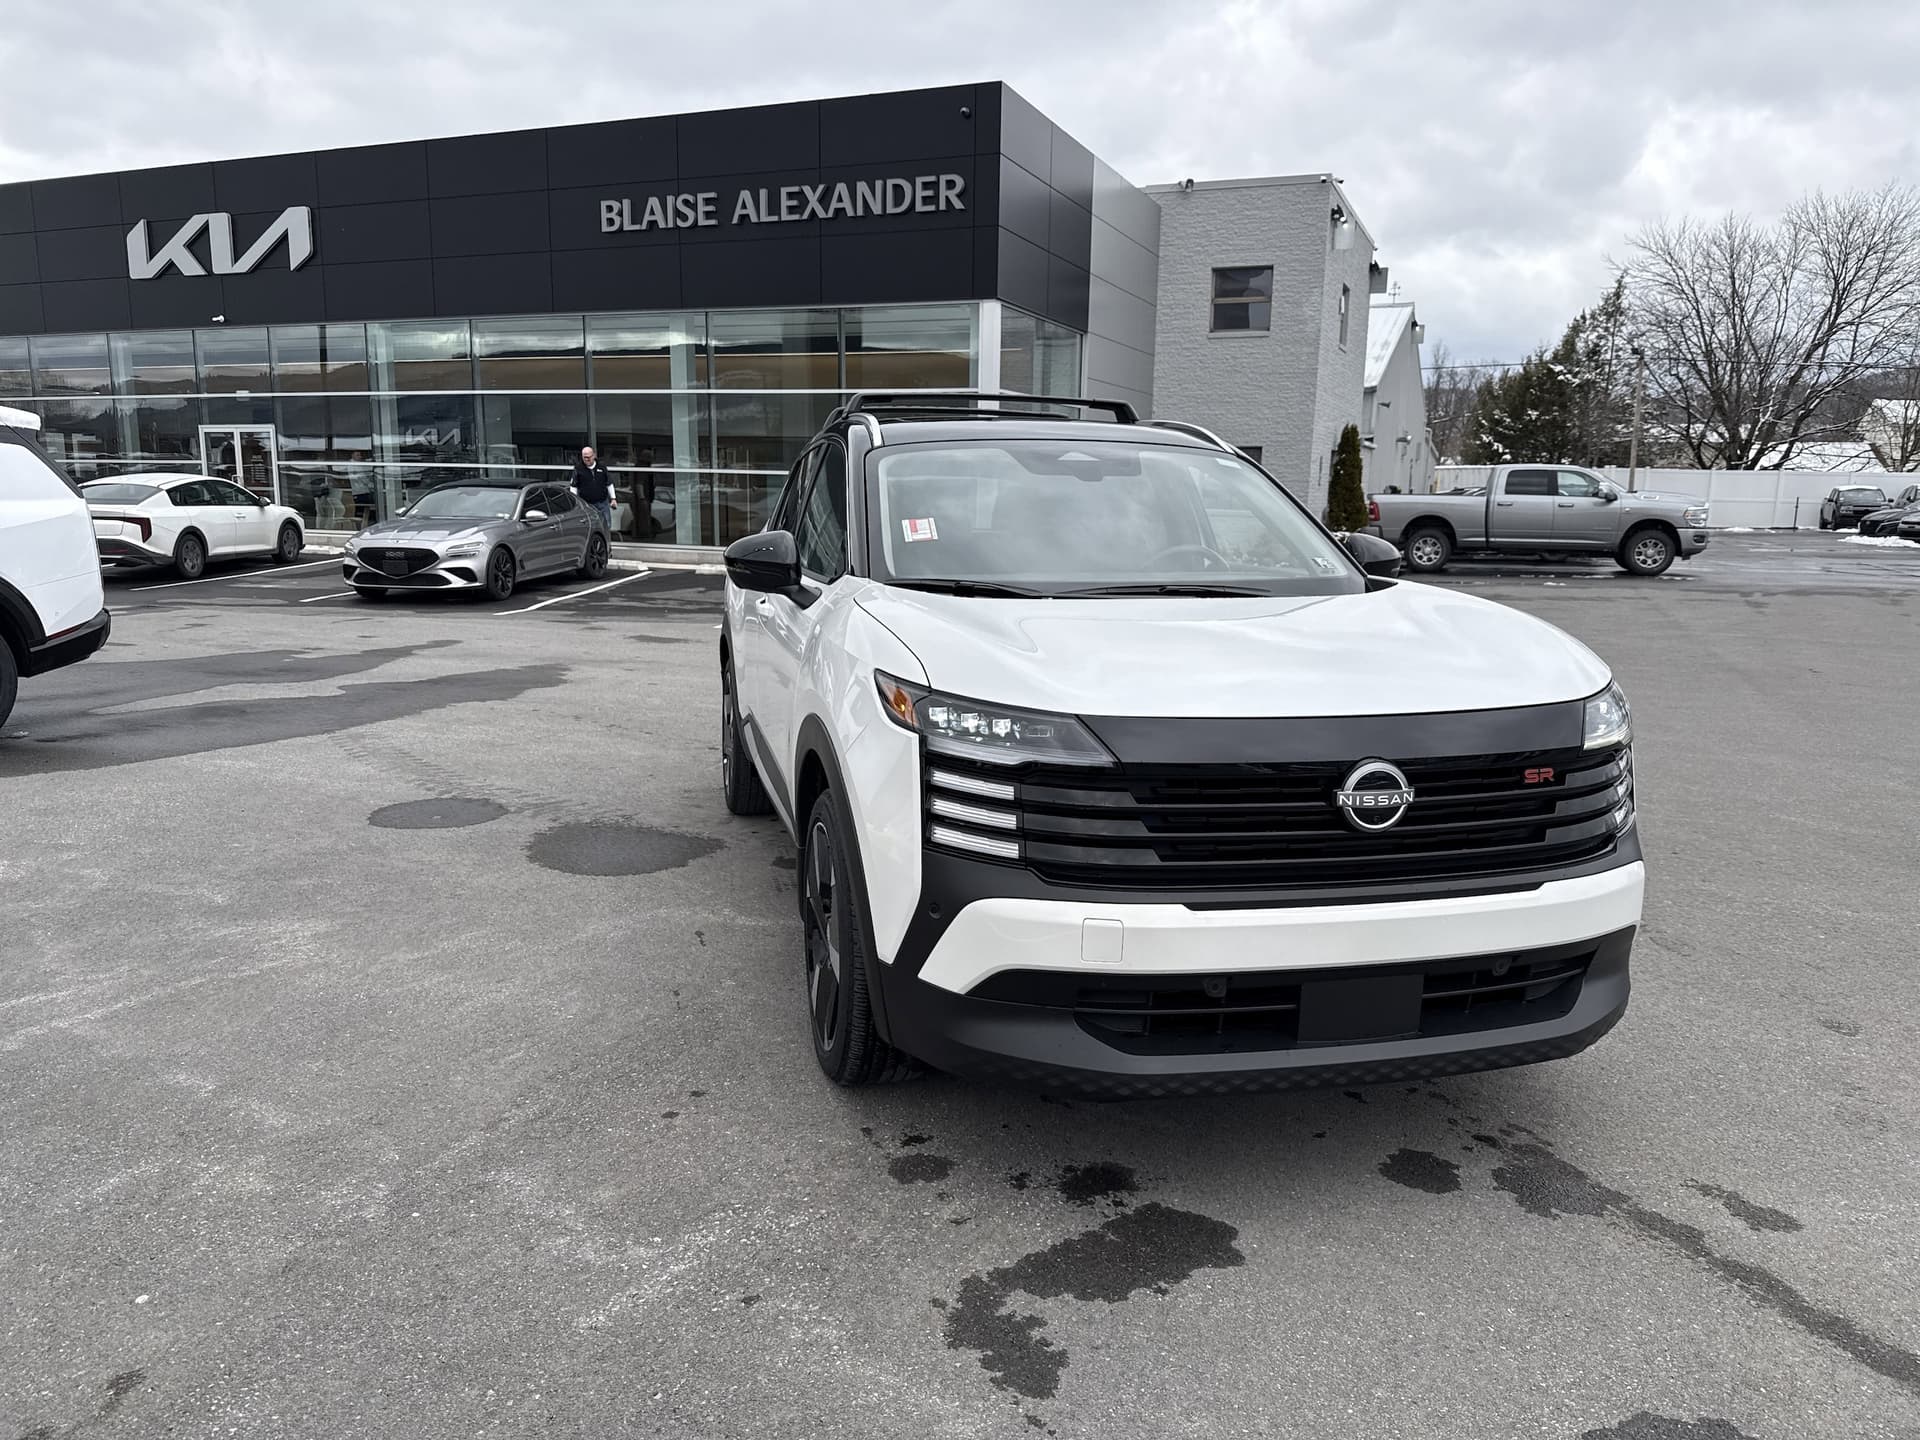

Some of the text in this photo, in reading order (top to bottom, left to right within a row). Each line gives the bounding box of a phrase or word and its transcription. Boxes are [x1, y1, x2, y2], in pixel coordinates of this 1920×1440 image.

[600, 173, 966, 232] BLAISE ALEXANDER
[126, 206, 313, 279] KIA
[1525, 768, 1555, 783] SR
[1339, 791, 1414, 806] NISSAN
